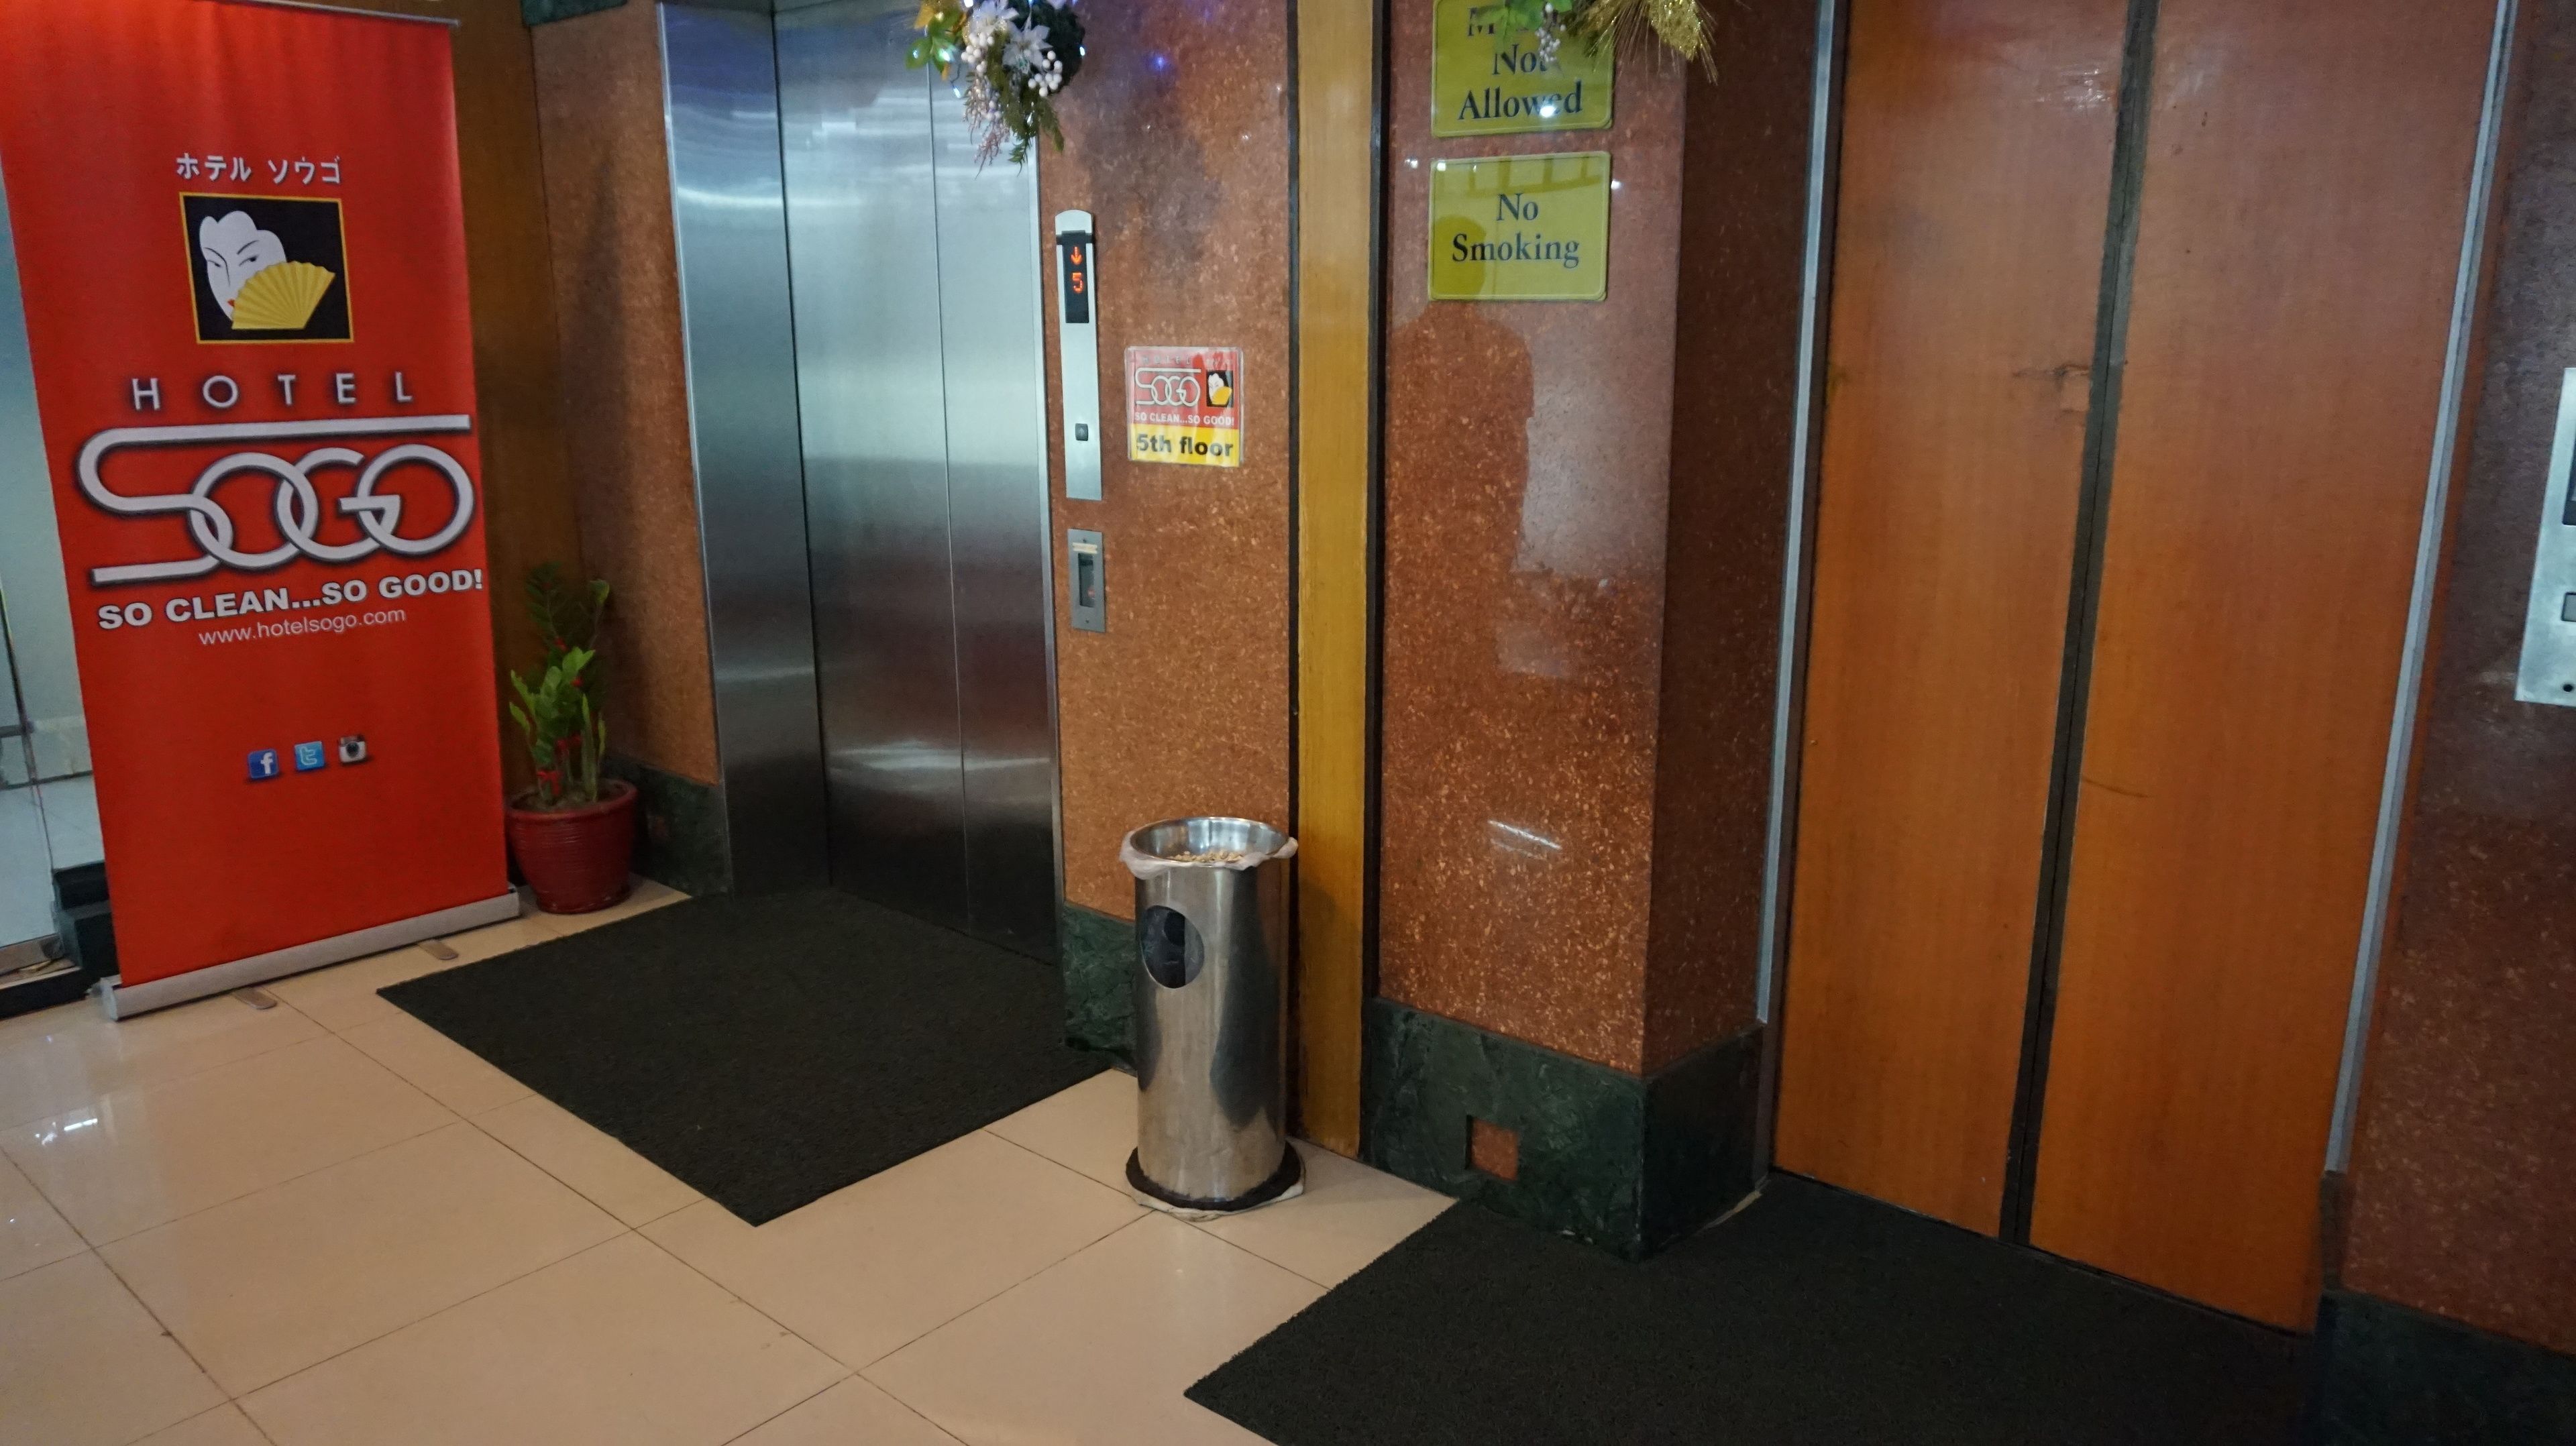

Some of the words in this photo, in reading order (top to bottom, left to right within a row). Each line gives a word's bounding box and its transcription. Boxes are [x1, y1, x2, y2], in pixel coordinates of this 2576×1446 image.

[1458, 80, 1582, 119] Allowed
[176, 152, 252, 182] ホテル
[268, 156, 341, 184] ソウゴ
[1496, 192, 1538, 221] No
[1452, 231, 1580, 269] Smoking
[1071, 272, 1083, 294] 5
[132, 372, 413, 411] HOTEL
[1135, 367, 1201, 406] SOGO
[1135, 412, 1147, 421] SO
[1203, 416, 1234, 426] GOOD!
[1136, 433, 1171, 453] 5th
[1179, 436, 1233, 457] floor
[78, 414, 475, 586] SOGO
[98, 604, 153, 630] SO
[378, 569, 482, 598] GOOD!
[199, 608, 406, 645] www.hotelsogo.com
